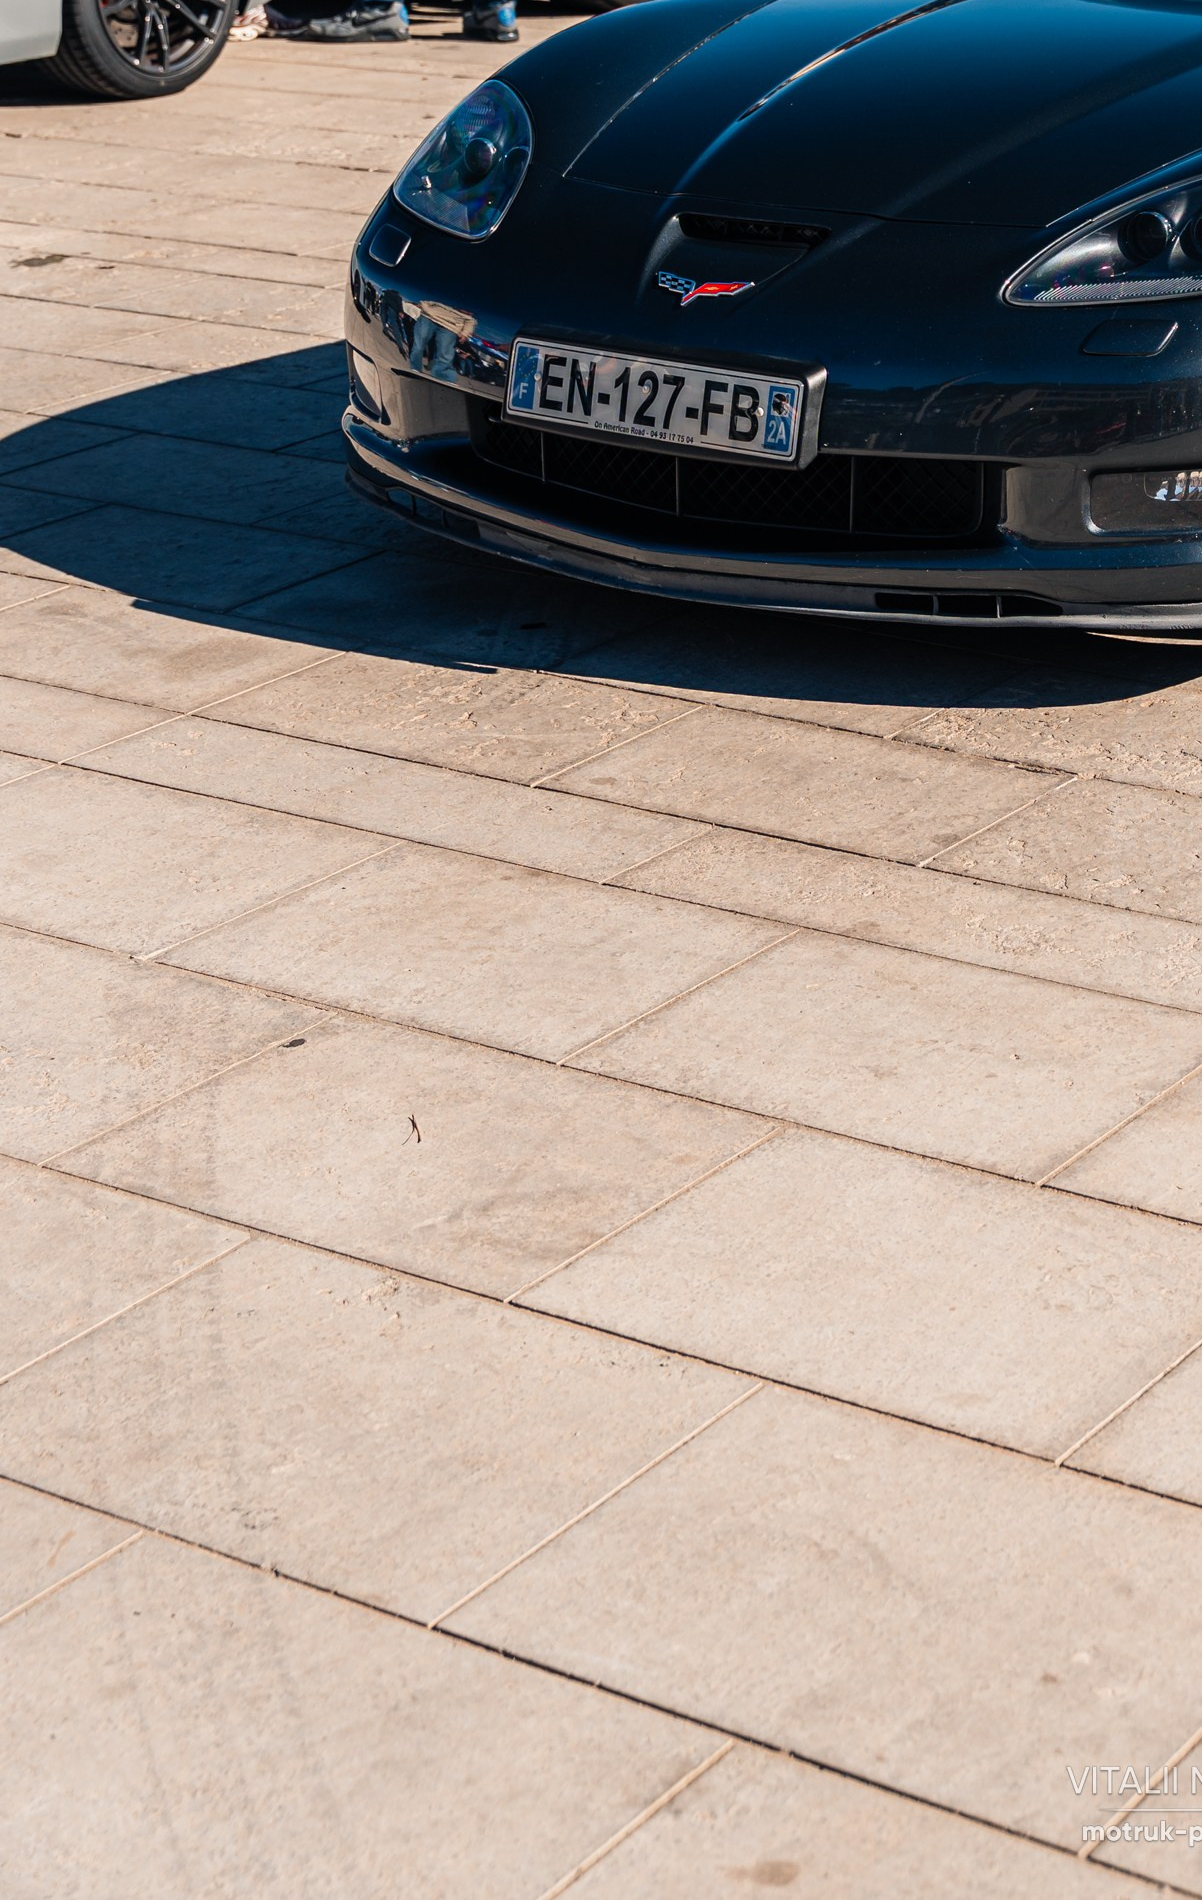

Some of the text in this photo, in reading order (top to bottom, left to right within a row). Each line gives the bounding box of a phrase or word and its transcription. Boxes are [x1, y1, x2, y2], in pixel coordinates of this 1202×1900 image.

[518, 382, 529, 400] F
[539, 353, 760, 443] EN-127-FB
[603, 422, 629, 433] American
[631, 426, 645, 436] Road
[650, 430, 658, 438] 04
[659, 432, 667, 440] 93
[669, 433, 675, 441] 17
[677, 434, 685, 443] 75
[686, 436, 694, 444] 04
[767, 420, 786, 445] 2A
